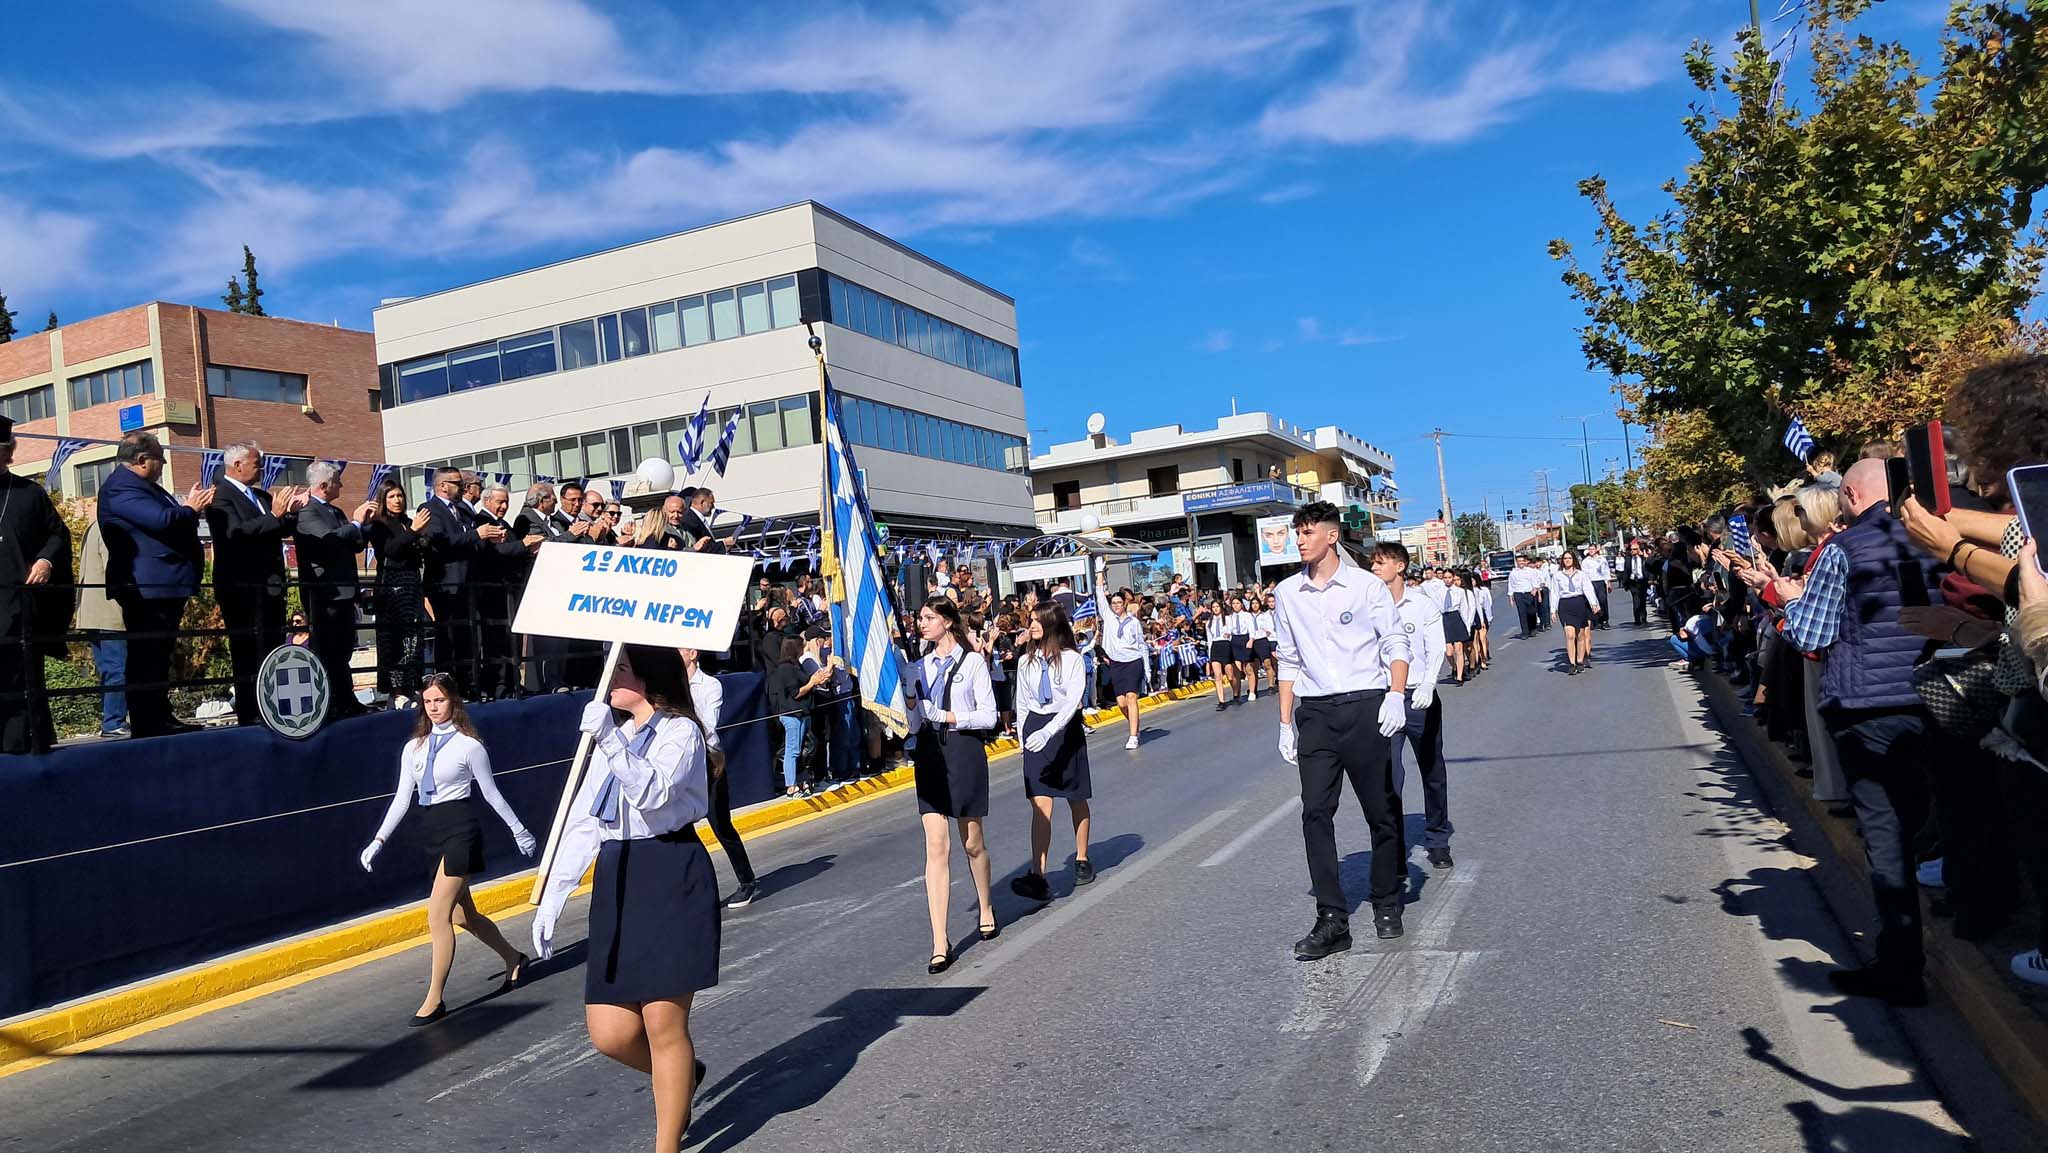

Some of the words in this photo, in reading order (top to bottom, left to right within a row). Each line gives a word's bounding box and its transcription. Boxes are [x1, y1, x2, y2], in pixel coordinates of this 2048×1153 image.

[1218, 483, 1270, 497] ΑΣΦΑΛΙΣΤΙΚΗ
[614, 554, 678, 577] ΛΥΚΕΙΟ
[644, 602, 714, 629] ΝΕΡΩΝ
